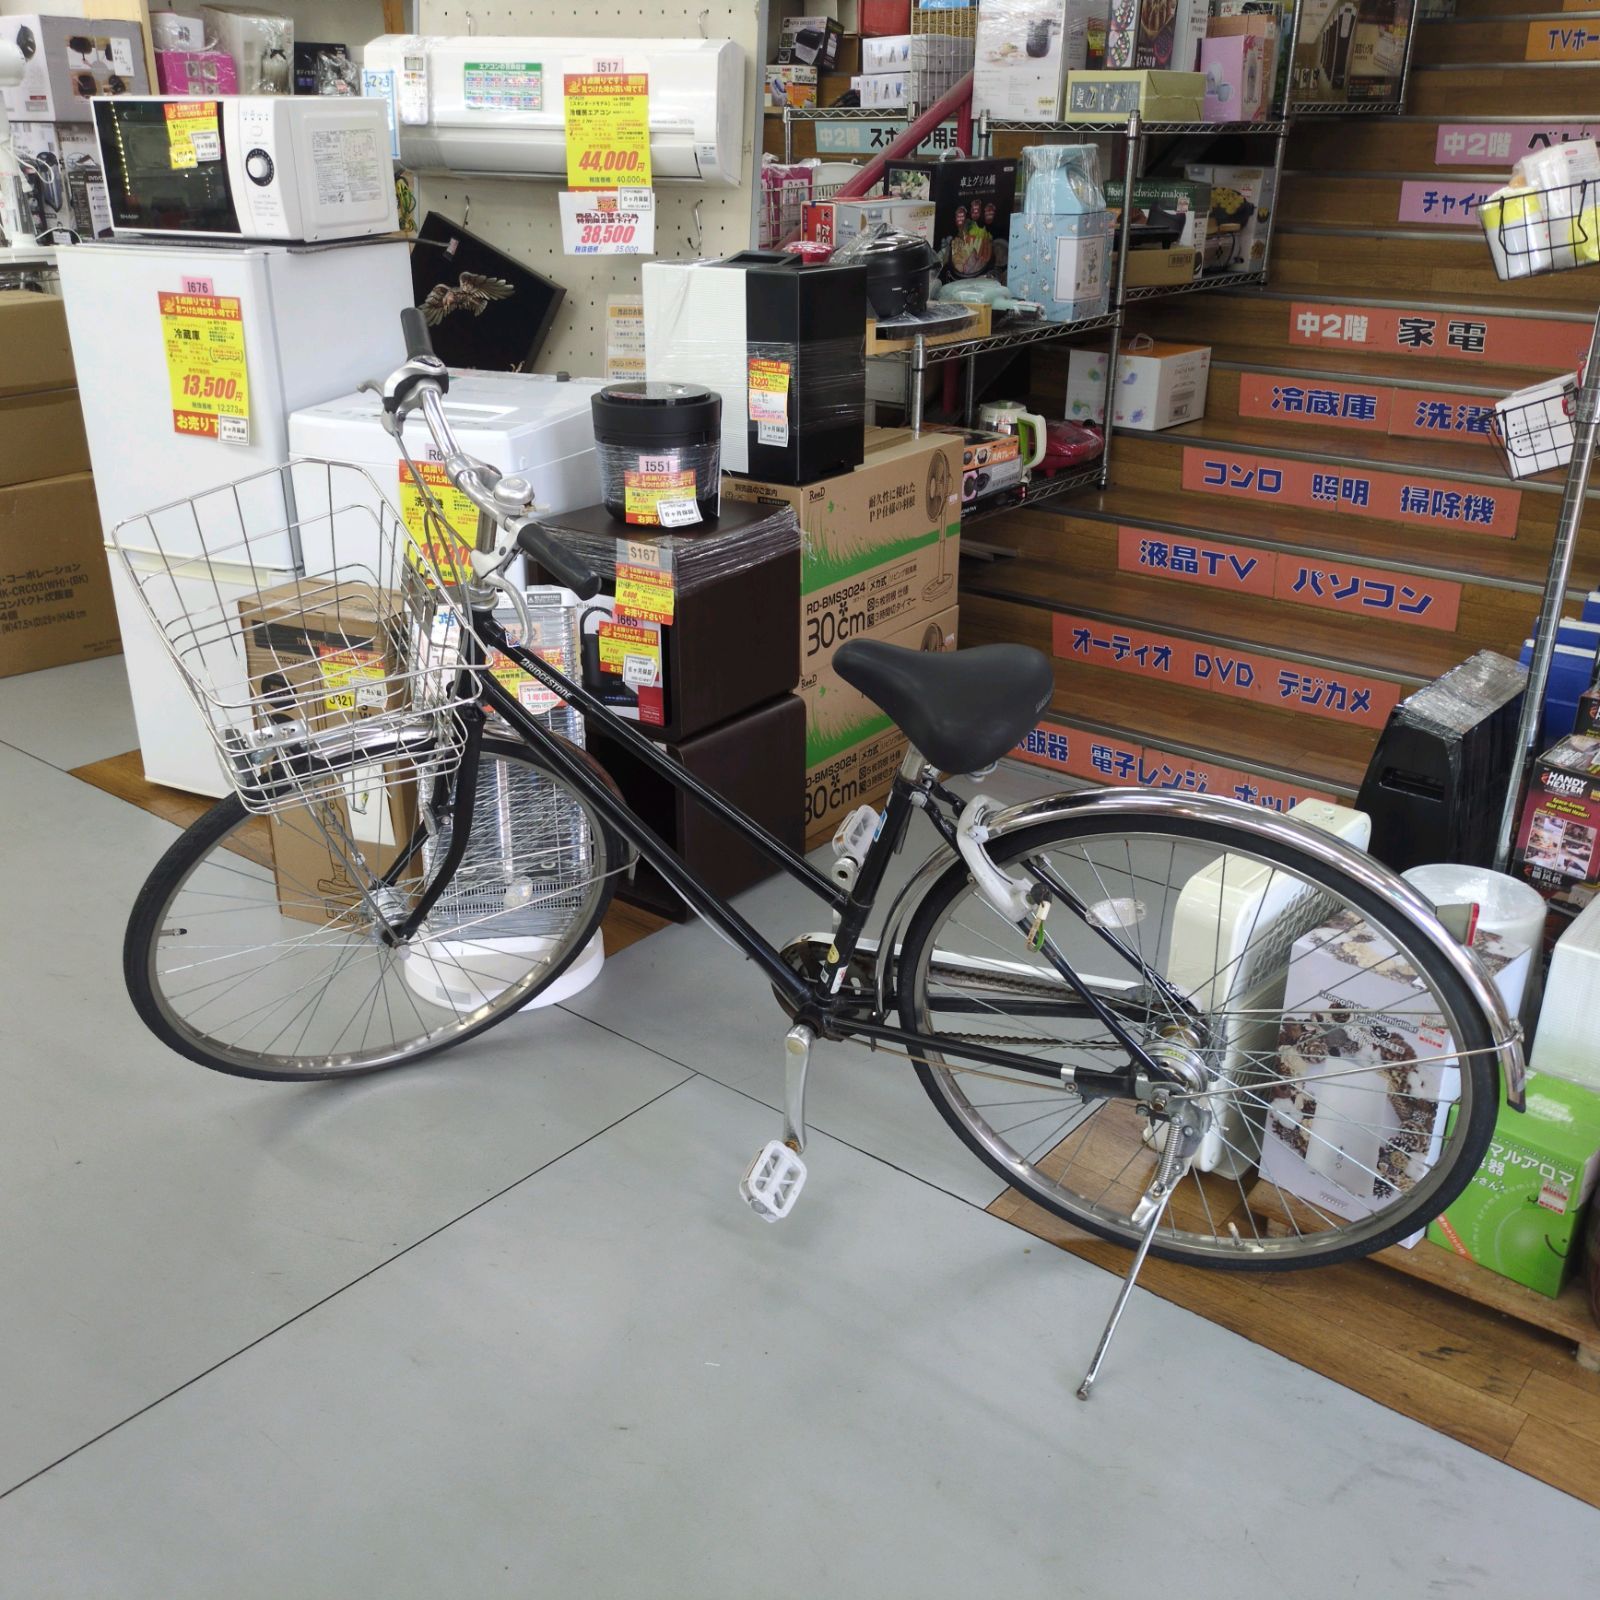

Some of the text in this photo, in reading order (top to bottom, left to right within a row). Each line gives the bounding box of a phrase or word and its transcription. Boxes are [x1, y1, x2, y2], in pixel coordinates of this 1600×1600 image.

[819, 127, 861, 148] 中2階
[1443, 131, 1513, 157] 中2階
[580, 225, 635, 245] 38,500
[174, 328, 201, 341] 冷蔵庫
[1297, 311, 1369, 342] 中2階
[1271, 386, 1378, 421] 冷蔵庫
[1203, 461, 1497, 525] コンロ 照明 掃除機
[1138, 540, 1434, 616] 液晶TV パソコン
[806, 581, 867, 616] RD-BMS3024
[807, 611, 866, 657] 30cm
[520, 658, 573, 698] BRIDGESTONE
[1072, 628, 1373, 714] オーディオ DVD デジカメ
[1547, 780, 1585, 795] HEATER
[1549, 771, 1588, 787] HANDY
